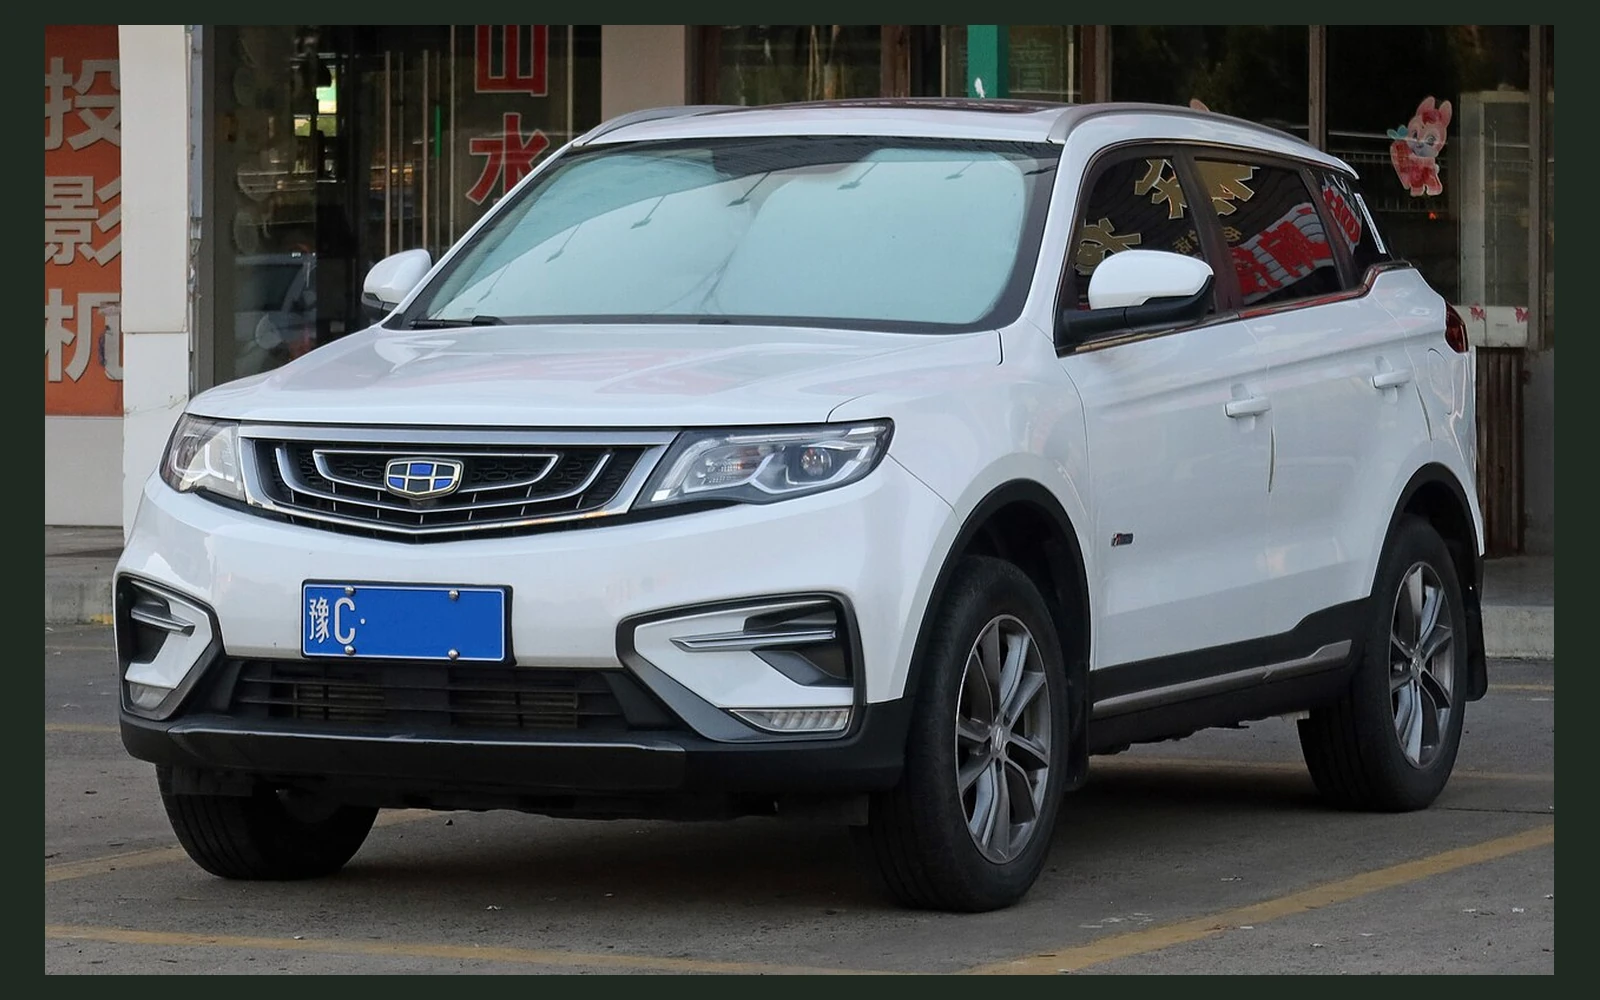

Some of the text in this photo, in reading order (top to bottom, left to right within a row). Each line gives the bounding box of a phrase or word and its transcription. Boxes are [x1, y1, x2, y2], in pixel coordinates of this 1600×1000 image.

[45, 57, 123, 383] 投影机
[465, 25, 551, 206] 山水
